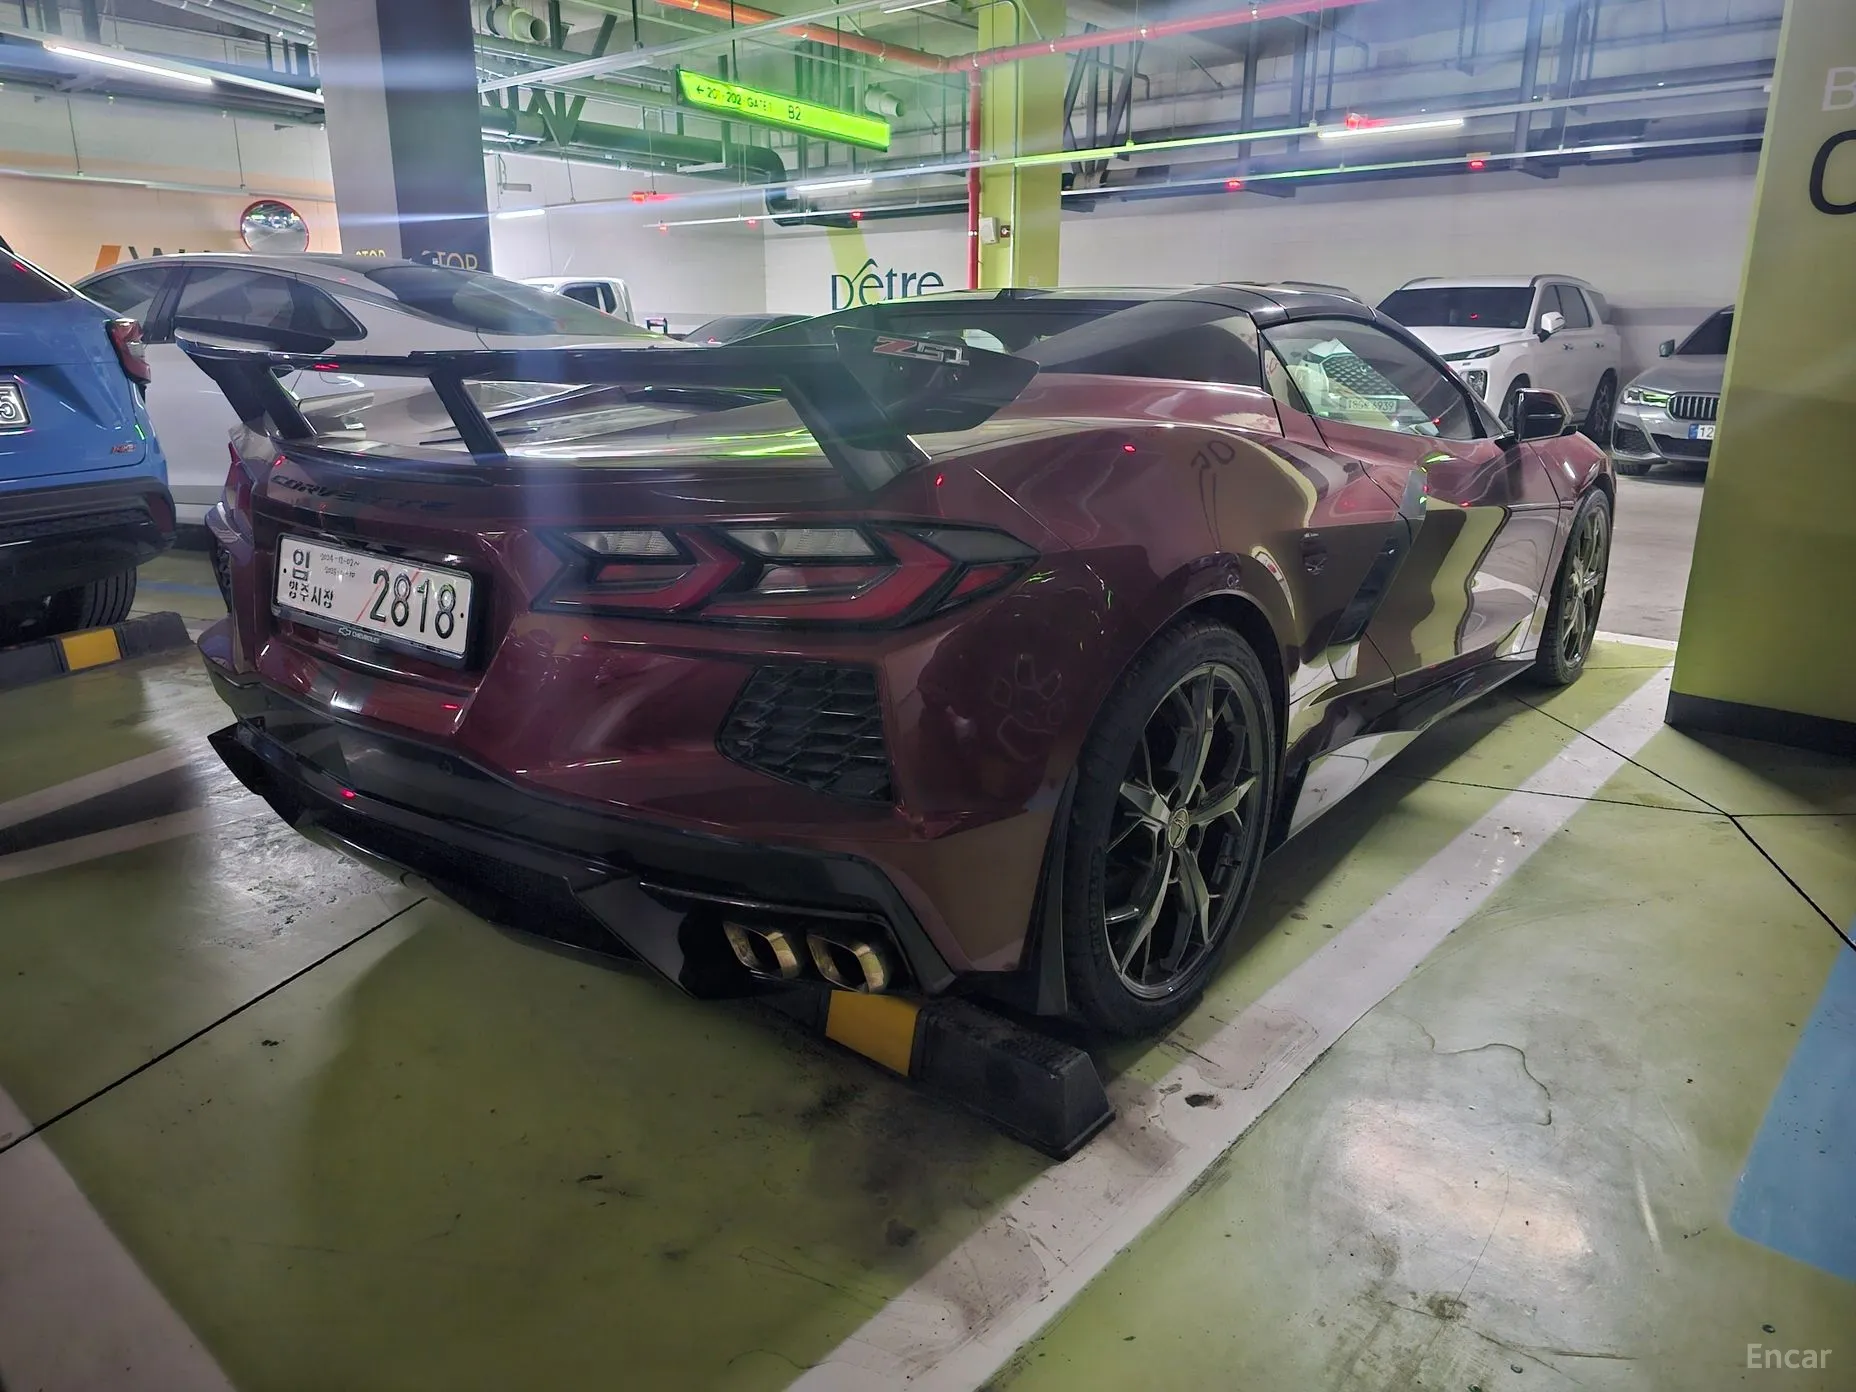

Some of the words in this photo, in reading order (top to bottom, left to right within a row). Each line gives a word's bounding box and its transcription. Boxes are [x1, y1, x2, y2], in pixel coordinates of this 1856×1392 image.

[788, 105, 801, 121] B2
[421, 250, 478, 271] TOP
[293, 549, 310, 581] 임
[289, 580, 334, 609] 양주시장
[370, 567, 457, 639] 2818
